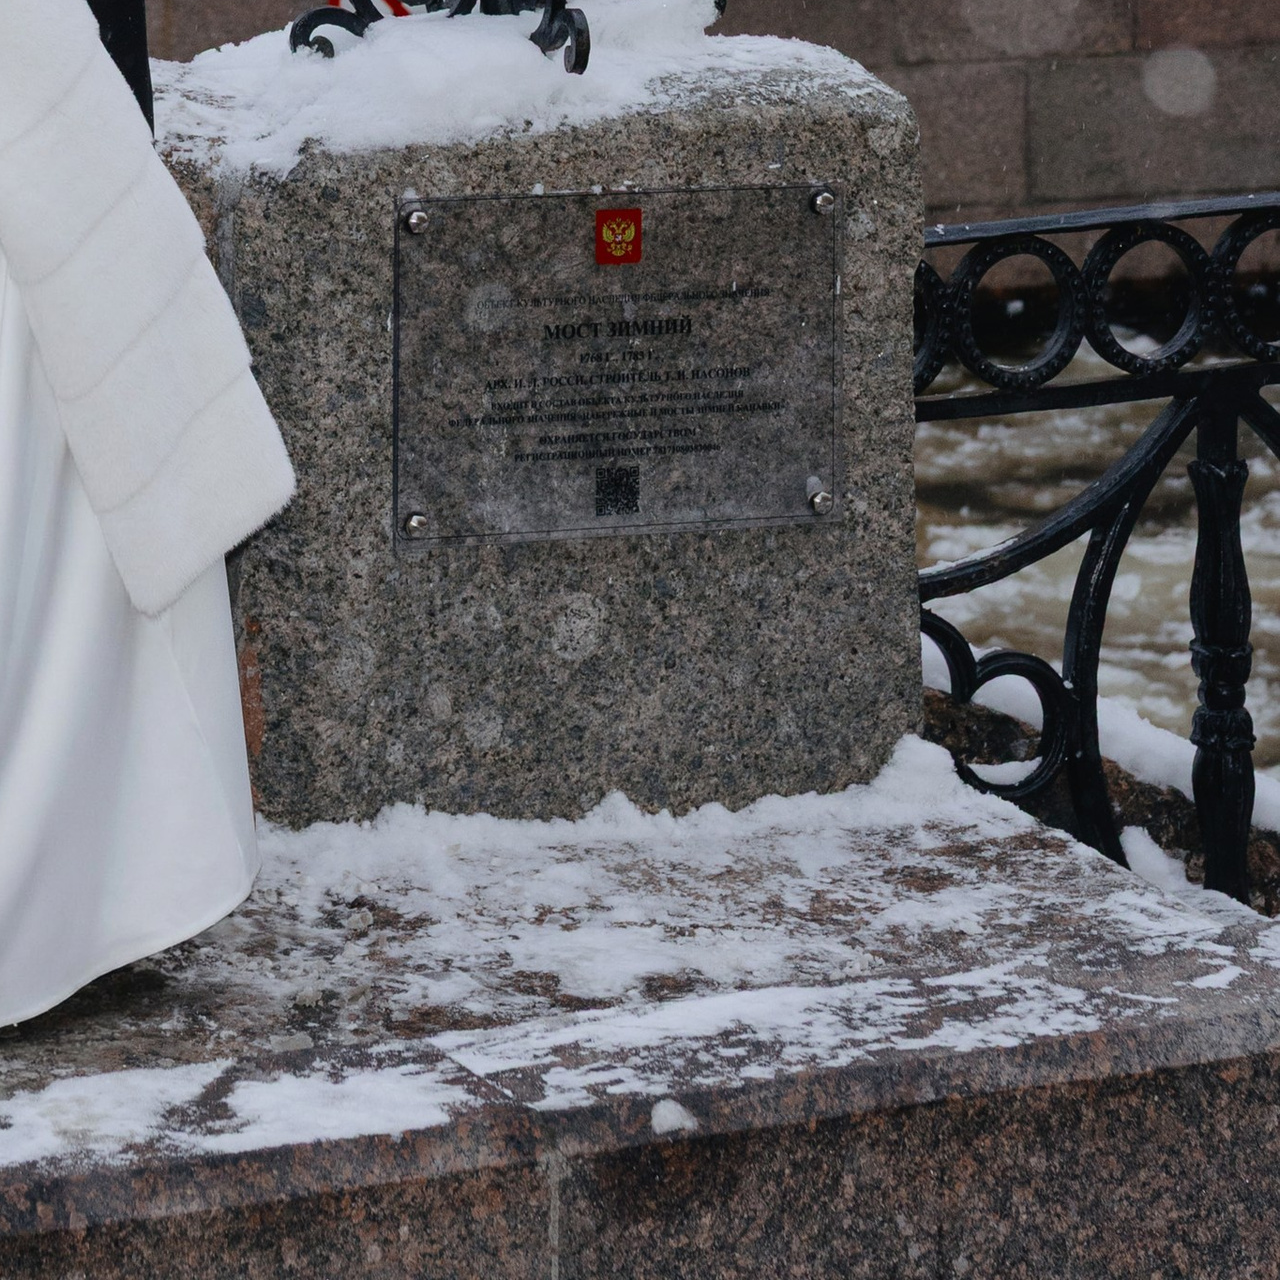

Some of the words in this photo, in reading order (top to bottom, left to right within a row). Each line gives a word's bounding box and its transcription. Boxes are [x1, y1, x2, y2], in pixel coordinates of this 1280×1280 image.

[476, 298, 515, 310] ОБЪЕКТ
[517, 294, 586, 308] КУЛЬТУРНОГО
[588, 293, 640, 305] НАСЛЕДИЯ
[642, 291, 716, 302] ФЕДЕРАЛЬНОГО
[543, 322, 602, 340] МОСТ
[606, 314, 692, 337] ЗИМНИЙ
[580, 352, 602, 363] 1768
[484, 377, 511, 389] АРХ.
[589, 370, 660, 385] СТРОИТЕЛЬ
[690, 367, 750, 380] НАСОНОВ
[491, 400, 528, 410] ВХОДИТ
[538, 398, 577, 408] СОСТАВ
[578, 396, 621, 406] ОБЪЕКТА
[624, 391, 692, 403] КУЛЬТУРНОГО
[694, 389, 744, 399] НАСЛЕДИЯ
[449, 415, 524, 426] ФЕДЕРАЛЬНОГО
[527, 412, 575, 423] ЗНАЧЕНИЯ
[659, 405, 694, 416] МОСТЫ
[697, 403, 734, 414] ЗИМНЕЙ
[539, 432, 610, 444] ОХРАНЯЕТСЯ
[612, 427, 697, 440] ГОСУДАРСТВОМ
[514, 448, 614, 461] РЕГИСТРАЦИОННЫЙ
[617, 447, 651, 456] НОМЕР
